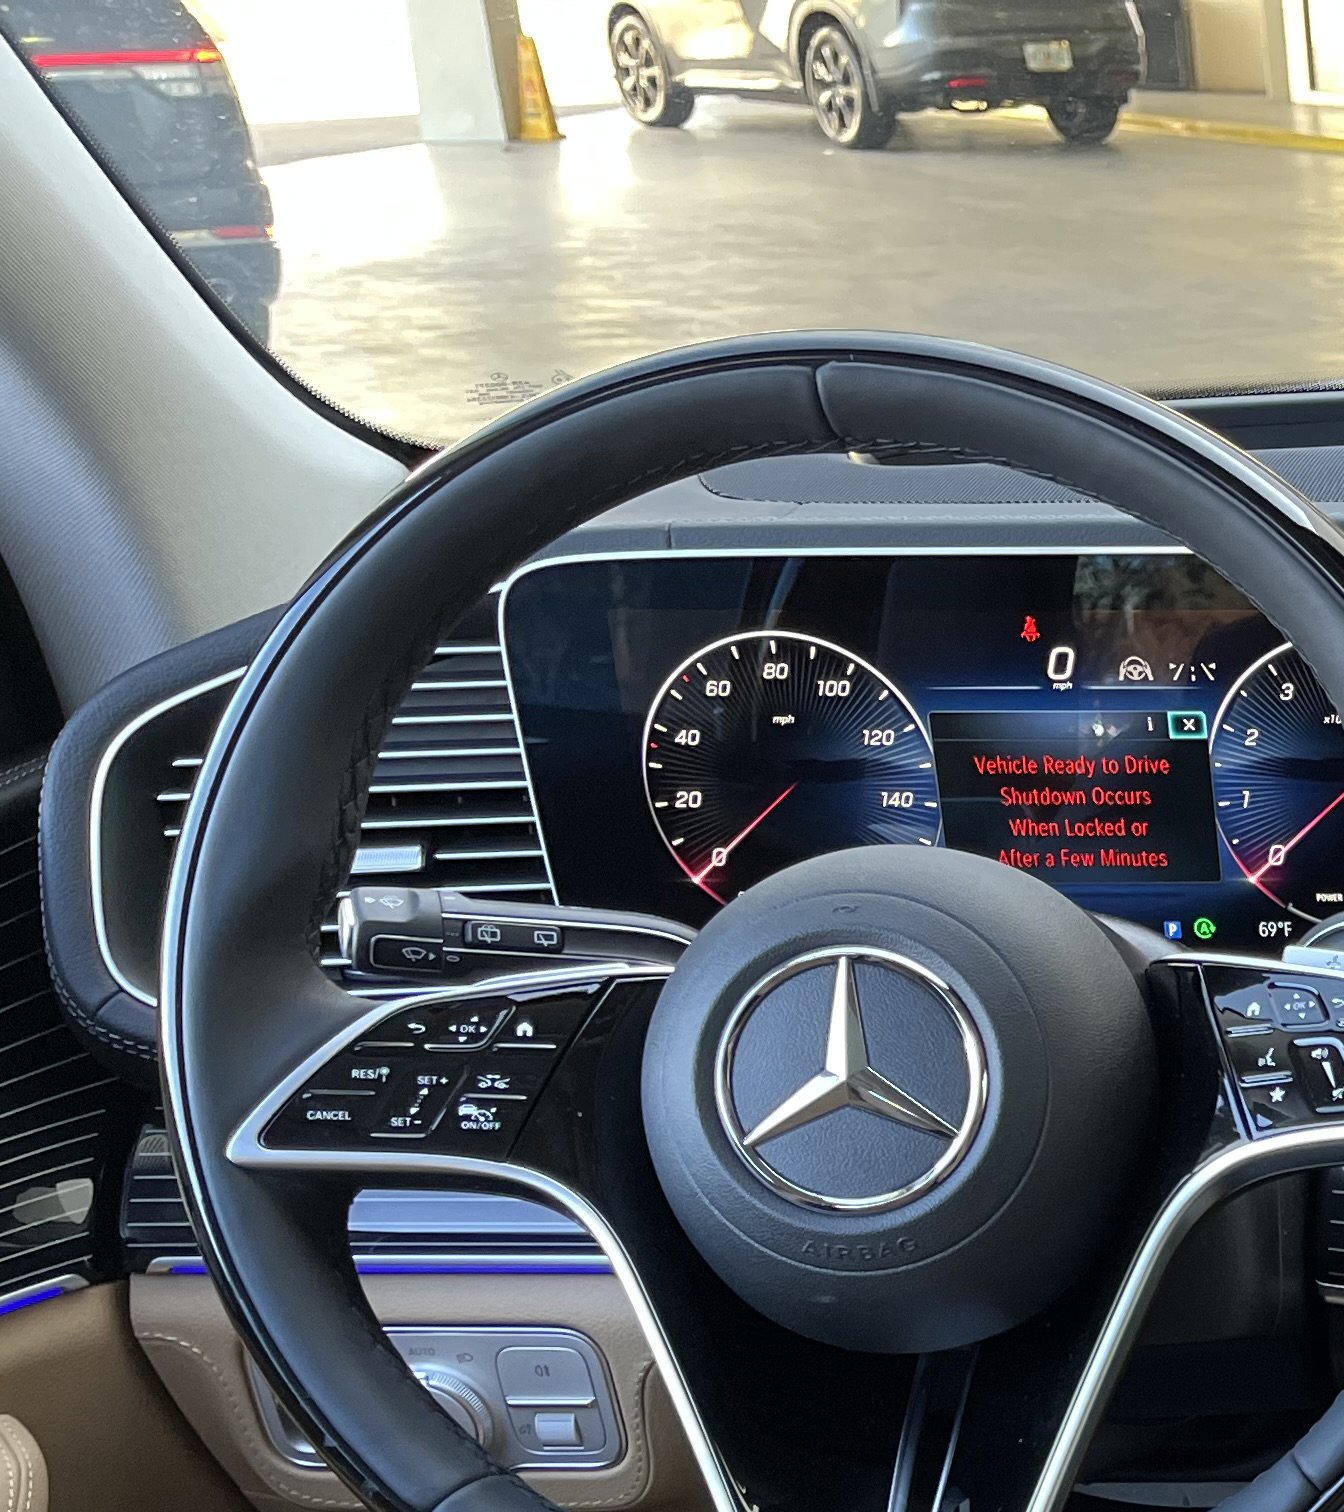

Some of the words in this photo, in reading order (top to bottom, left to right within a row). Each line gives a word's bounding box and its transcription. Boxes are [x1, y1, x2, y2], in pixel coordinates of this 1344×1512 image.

[762, 663, 789, 680] 80
[1047, 647, 1075, 680] 0
[705, 680, 731, 697] 60
[816, 680, 850, 697] 100
[1053, 681, 1073, 691] mph
[1279, 683, 1294, 700] 3
[772, 715, 795, 726] mph
[674, 729, 700, 746] 40
[862, 729, 895, 746] 120
[1244, 729, 1259, 746] 2
[973, 755, 1038, 775] Vehicle
[1043, 756, 1096, 779] Ready
[1102, 758, 1120, 774] to
[1124, 755, 1170, 775] Drive
[674, 791, 702, 808] 20
[881, 791, 913, 808] 140
[1000, 786, 1086, 807] Shutdown
[1092, 786, 1152, 806] Occurs
[1242, 791, 1250, 808] 1
[1008, 818, 1059, 837] When
[1065, 818, 1126, 837] Locked
[1131, 823, 1149, 837] or
[711, 848, 727, 866] 0
[998, 849, 1040, 868] After
[1046, 854, 1056, 867] a
[1061, 849, 1094, 867] Few
[1100, 849, 1168, 868] Minutes
[1268, 845, 1285, 865] 0
[1316, 893, 1344, 902] POWER
[1258, 922, 1292, 938] 69°F
[459, 1025, 477, 1033] OK
[306, 1110, 352, 1121] CANCEL
[461, 1121, 501, 1130] ON/OFF
[408, 1347, 436, 1357] AUTO
